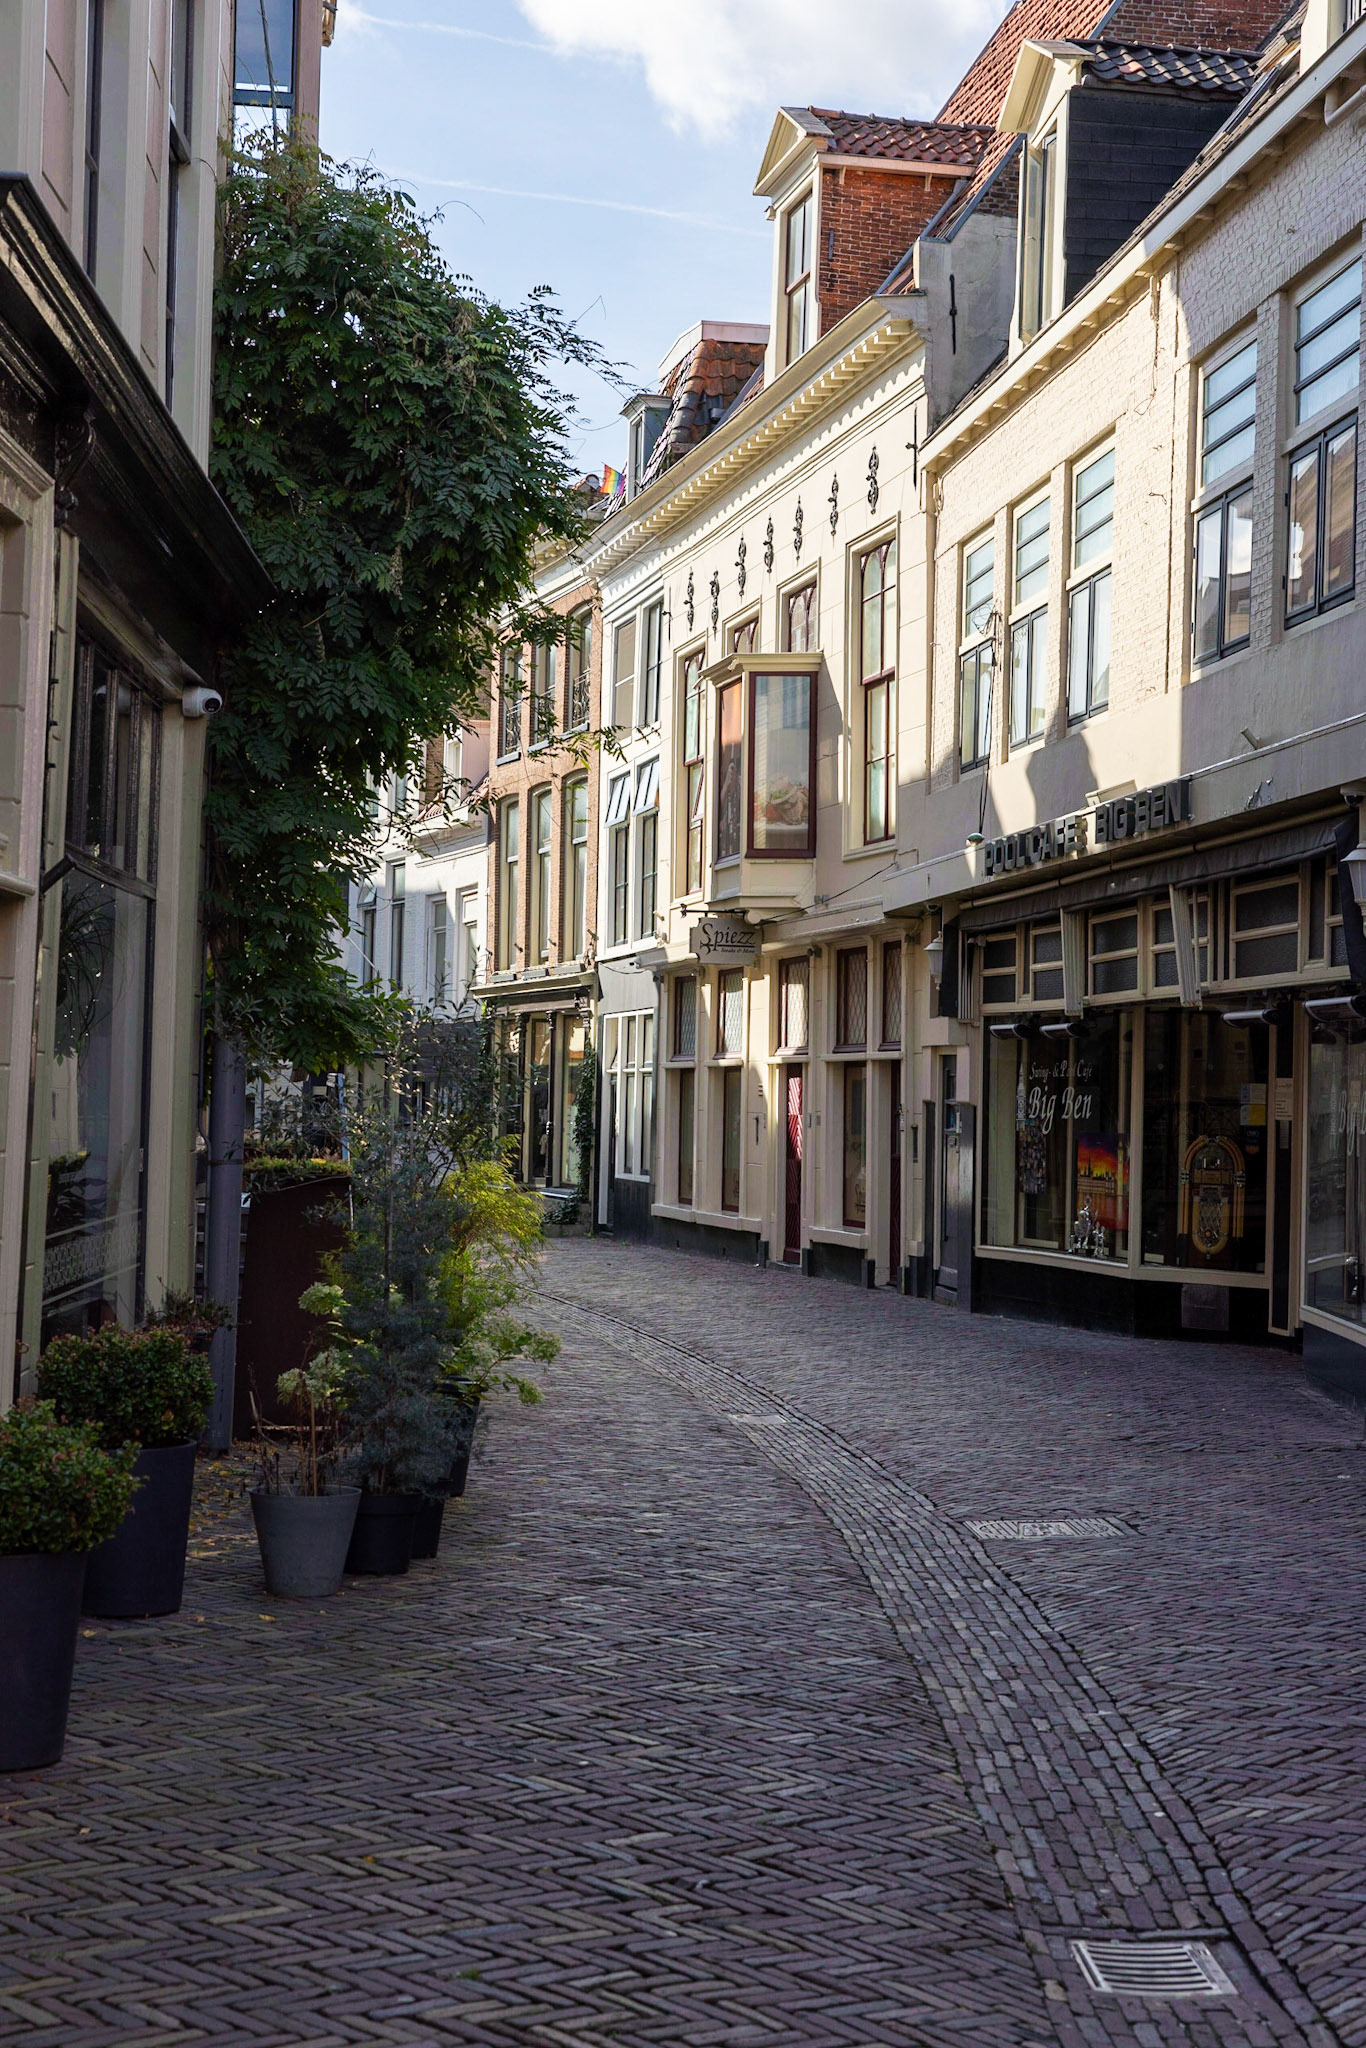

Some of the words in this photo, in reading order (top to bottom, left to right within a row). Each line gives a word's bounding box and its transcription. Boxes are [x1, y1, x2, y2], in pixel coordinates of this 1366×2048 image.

[985, 832, 1027, 875] POOL
[1031, 816, 1078, 864] CAFE
[1095, 800, 1128, 844] BIG
[1135, 779, 1185, 832] BEN
[700, 923, 756, 955] Spiezz
[1029, 1085, 1057, 1134] Big
[1062, 1086, 1092, 1119] Ben
